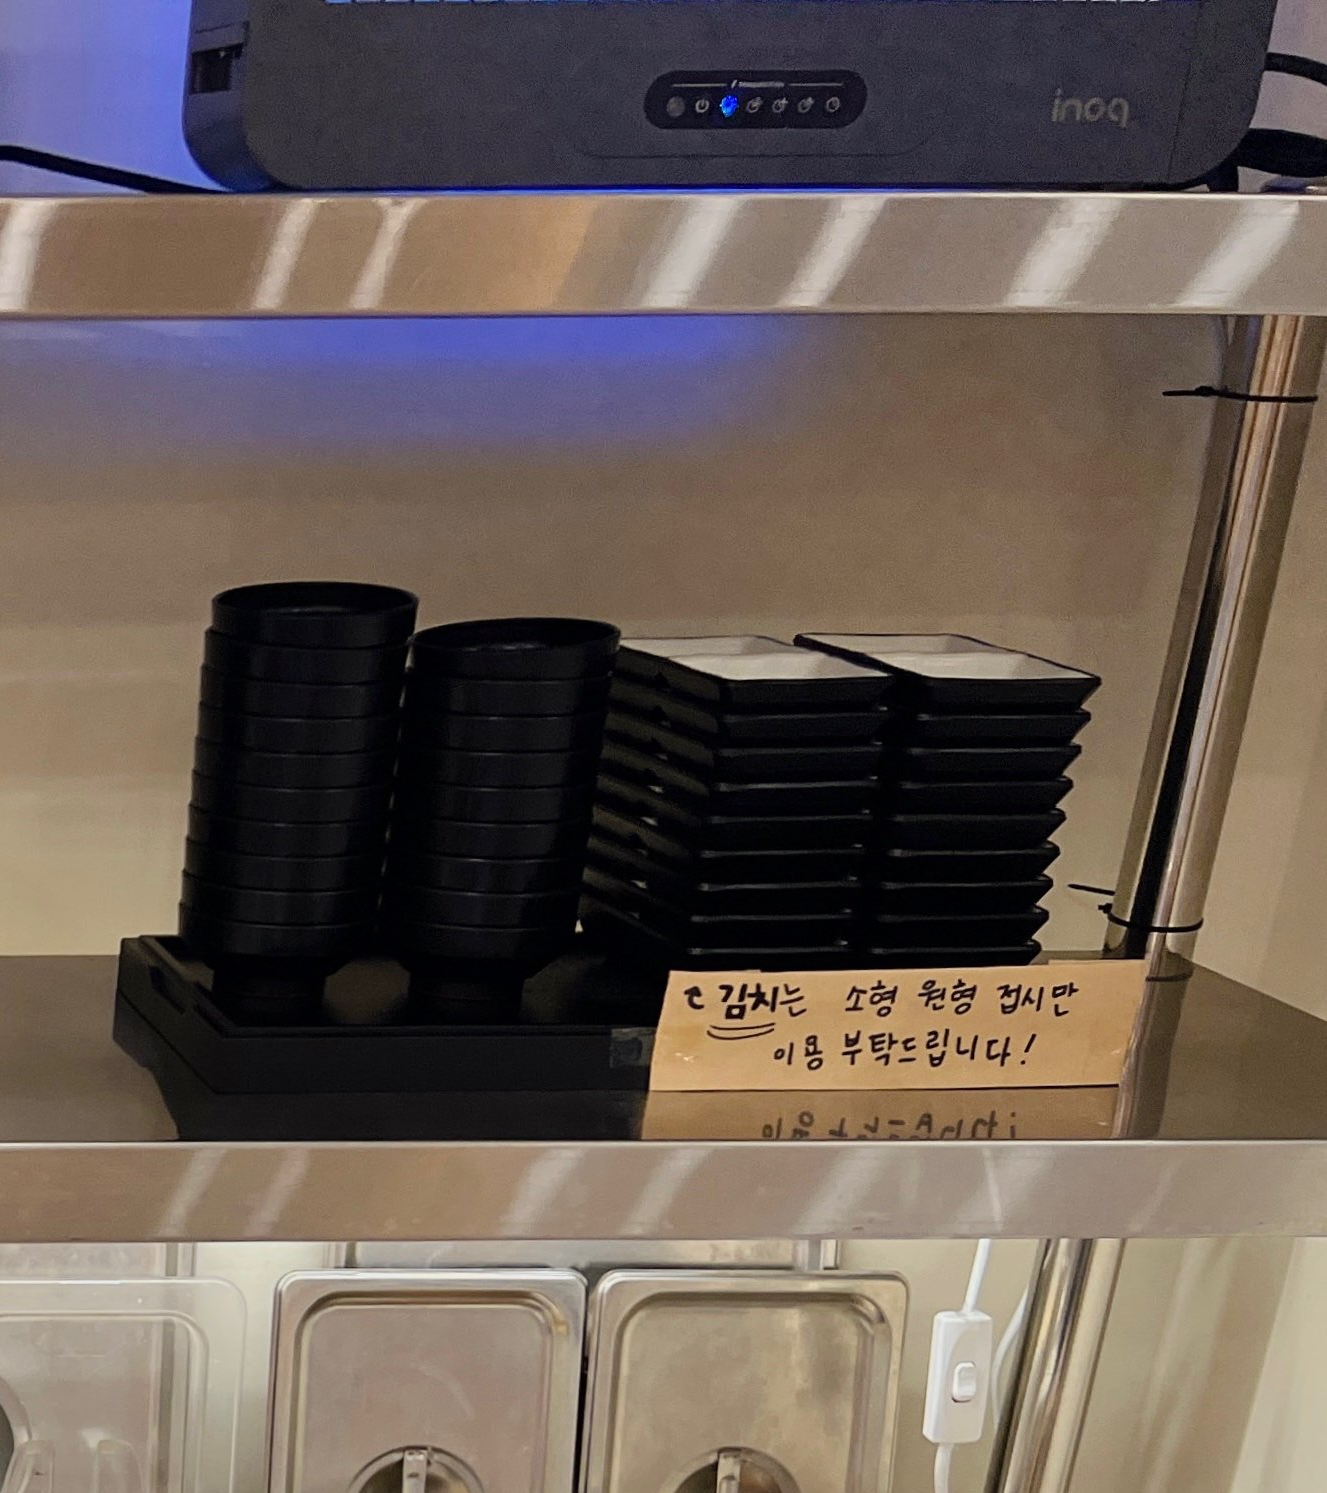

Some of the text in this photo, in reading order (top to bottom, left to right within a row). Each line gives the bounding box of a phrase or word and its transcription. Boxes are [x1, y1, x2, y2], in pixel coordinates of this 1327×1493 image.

[1051, 87, 1130, 128] inoq
[718, 979, 1079, 1020] 김치는 소형 원형 접시만
[773, 1028, 1037, 1071] 이용 부탁드립니다!
